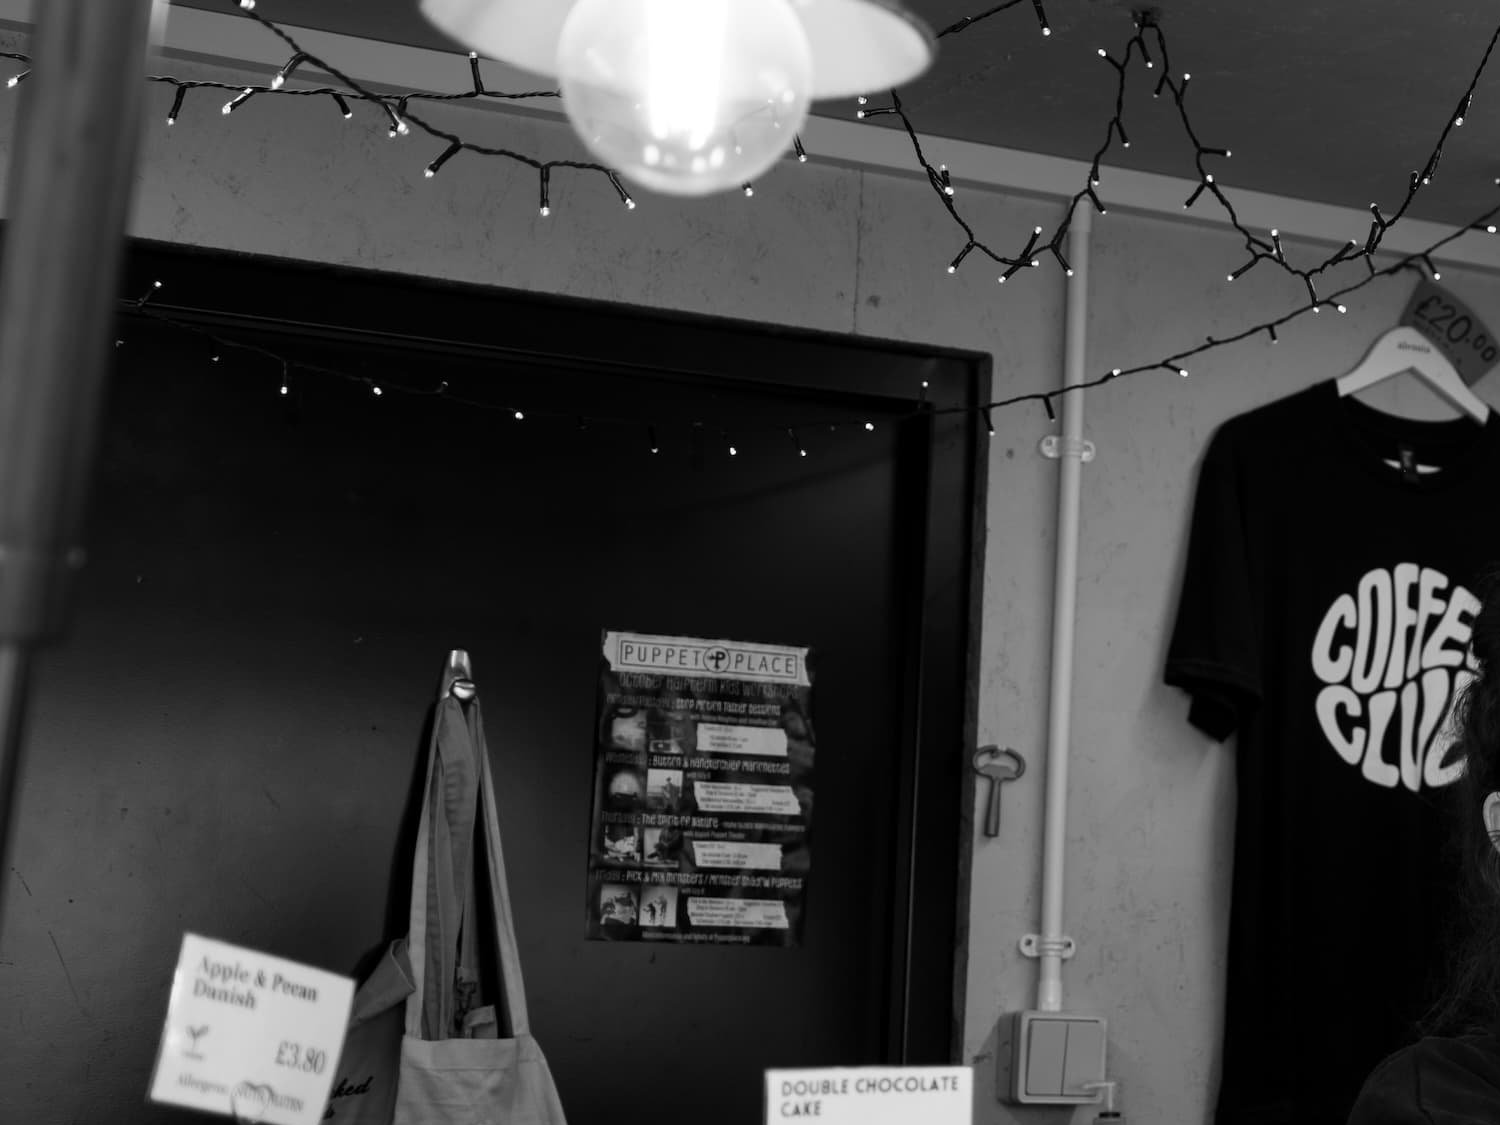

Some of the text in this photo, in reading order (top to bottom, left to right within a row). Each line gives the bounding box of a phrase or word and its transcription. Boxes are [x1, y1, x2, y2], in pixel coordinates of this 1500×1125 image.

[1413, 295, 1497, 363] £20.00
[1311, 562, 1484, 695] COFFE
[623, 645, 795, 676] PUPPET PLACE
[193, 977, 257, 1010] Danish
[201, 955, 319, 1003] Apple & Pecan
[274, 1039, 326, 1075] £3.80
[780, 1075, 960, 1097] DOUBLE CHOCOLATE
[780, 1101, 822, 1118] CAKE
